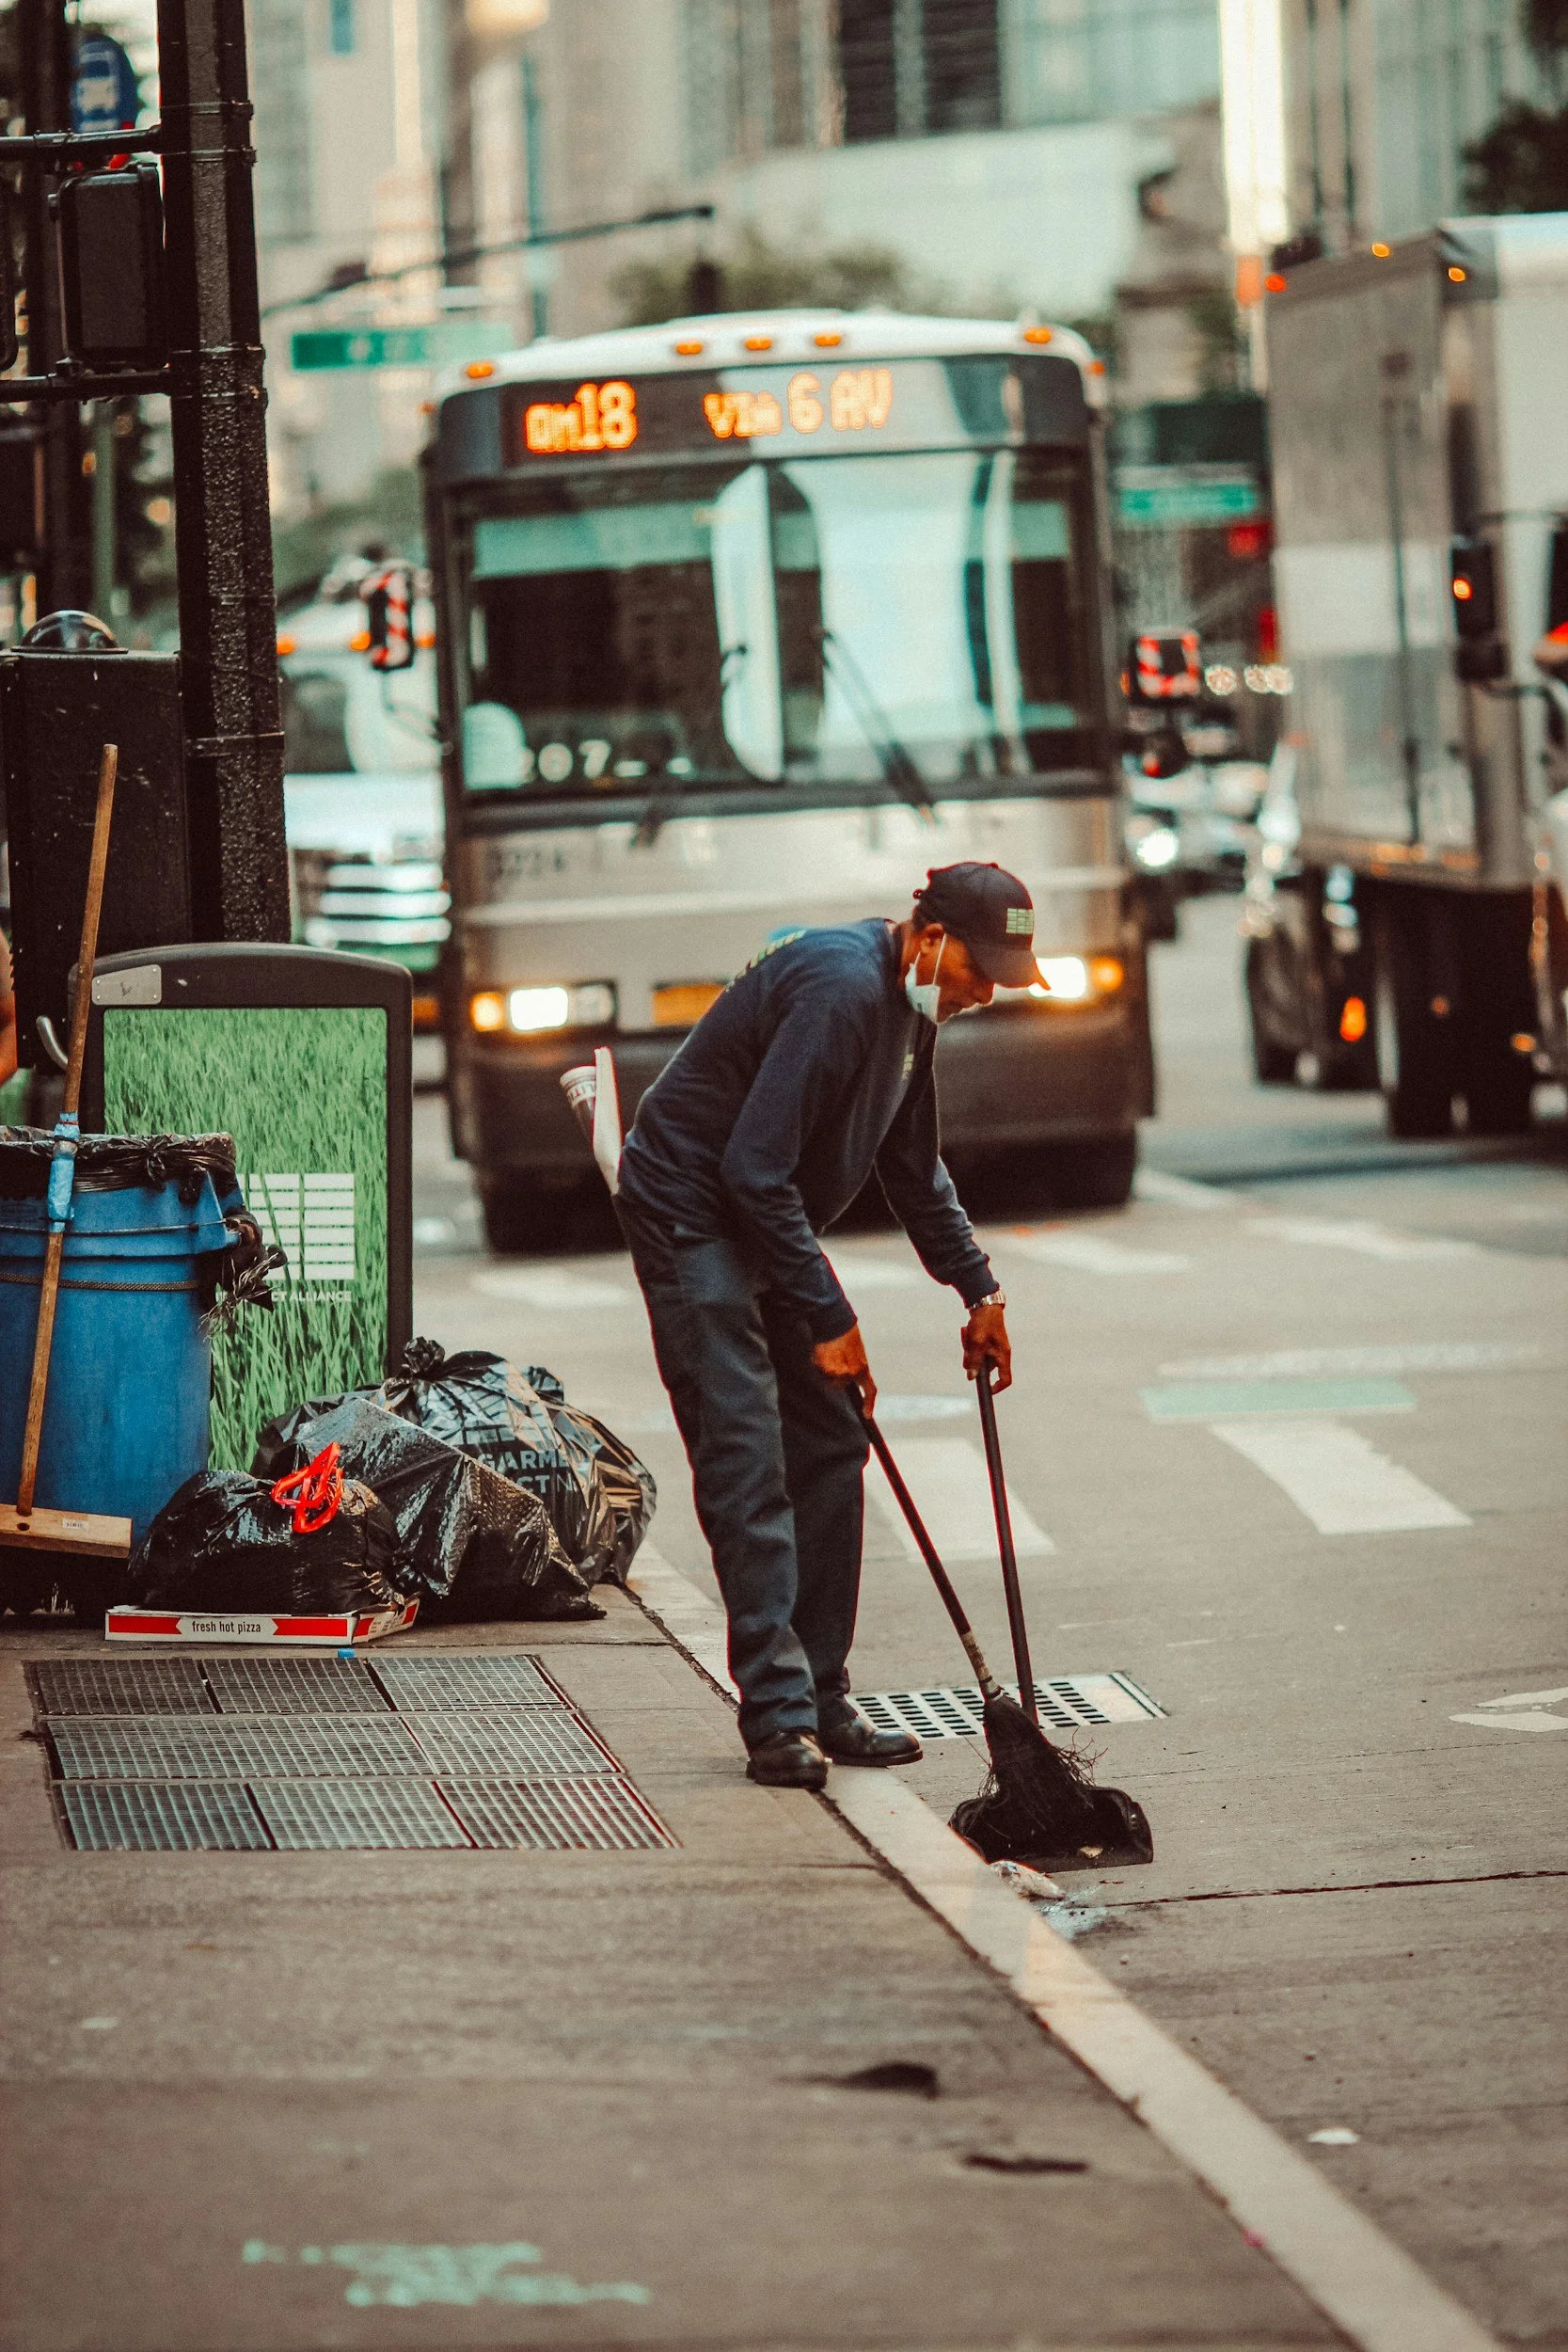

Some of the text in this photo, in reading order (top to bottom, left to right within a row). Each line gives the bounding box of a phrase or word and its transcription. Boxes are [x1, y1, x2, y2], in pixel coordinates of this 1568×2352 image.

[787, 373, 825, 433] 6
[289, 1290, 353, 1303] ALLIANCE
[191, 1620, 262, 1635] fresh hot pizza
